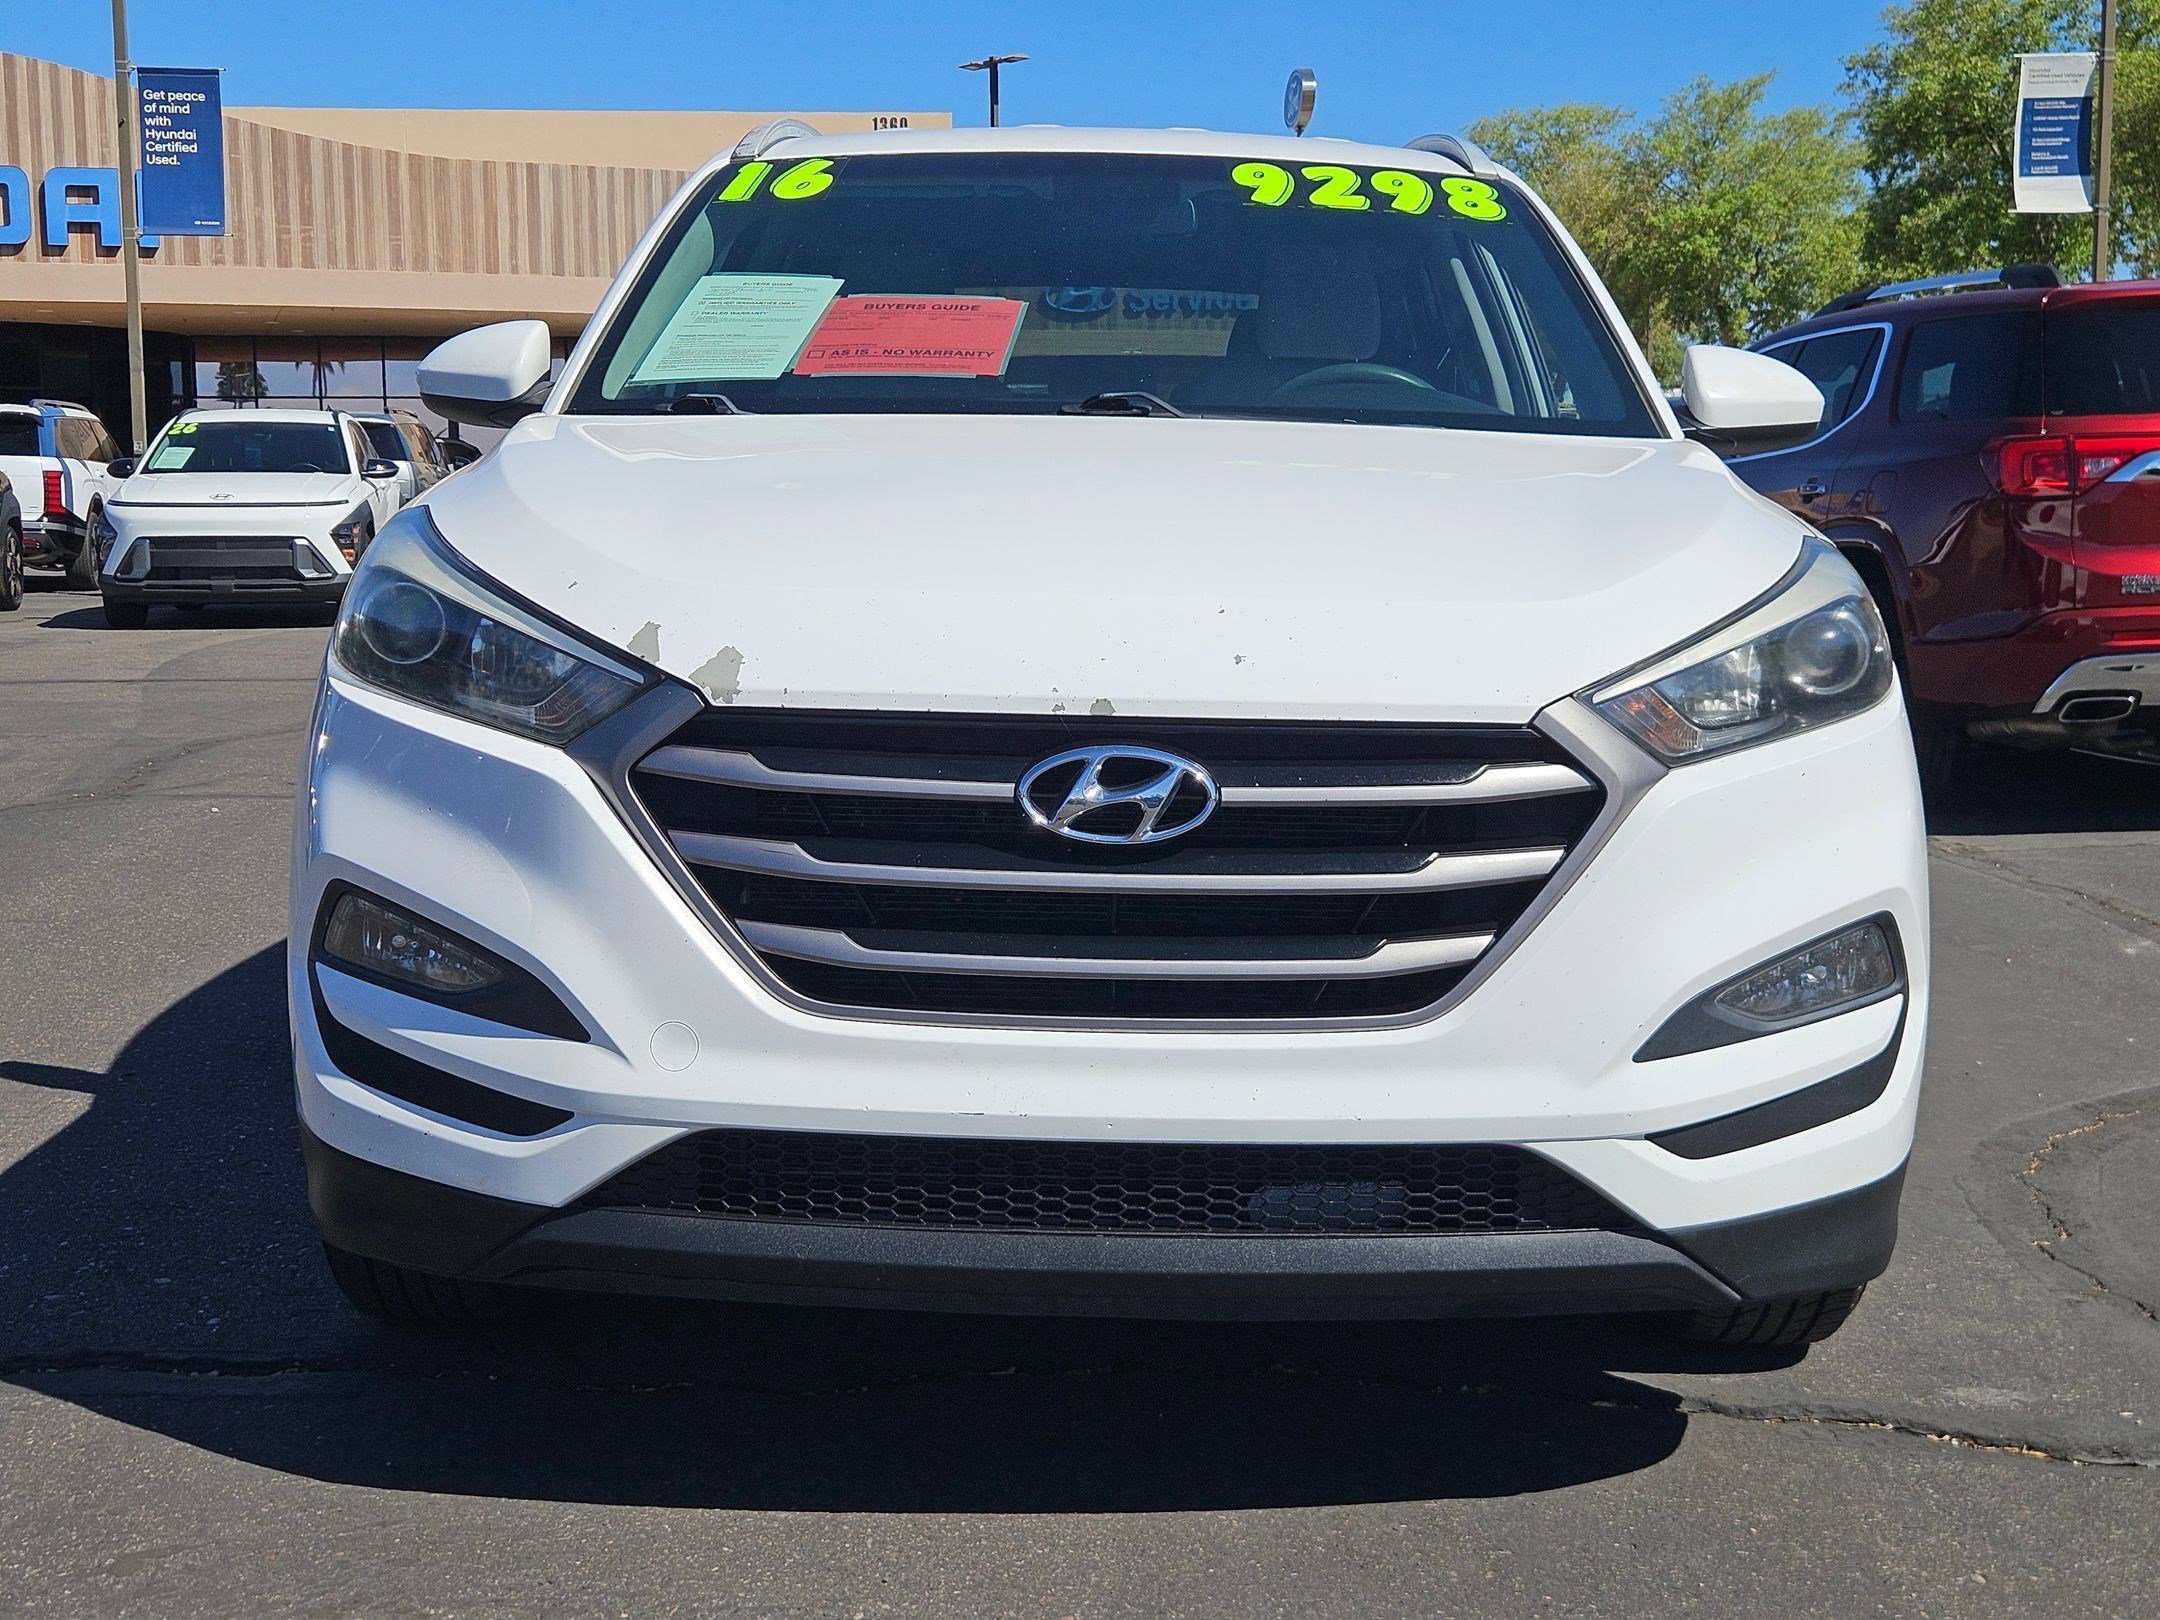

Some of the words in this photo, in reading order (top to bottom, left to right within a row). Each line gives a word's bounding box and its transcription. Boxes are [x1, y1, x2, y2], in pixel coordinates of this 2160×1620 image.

[143, 89, 165, 100] Get
[168, 91, 206, 102] peace
[143, 102, 157, 113] of
[159, 103, 190, 114] mind
[144, 115, 171, 126] with
[872, 117, 908, 130] 1360
[145, 128, 197, 141] Hyundai
[145, 141, 198, 153] Certified
[146, 154, 180, 165] Used.
[718, 158, 835, 201] 16
[1231, 162, 1507, 221] 9298
[909, 349, 995, 358] WARRANTY
[168, 422, 199, 435] 26
